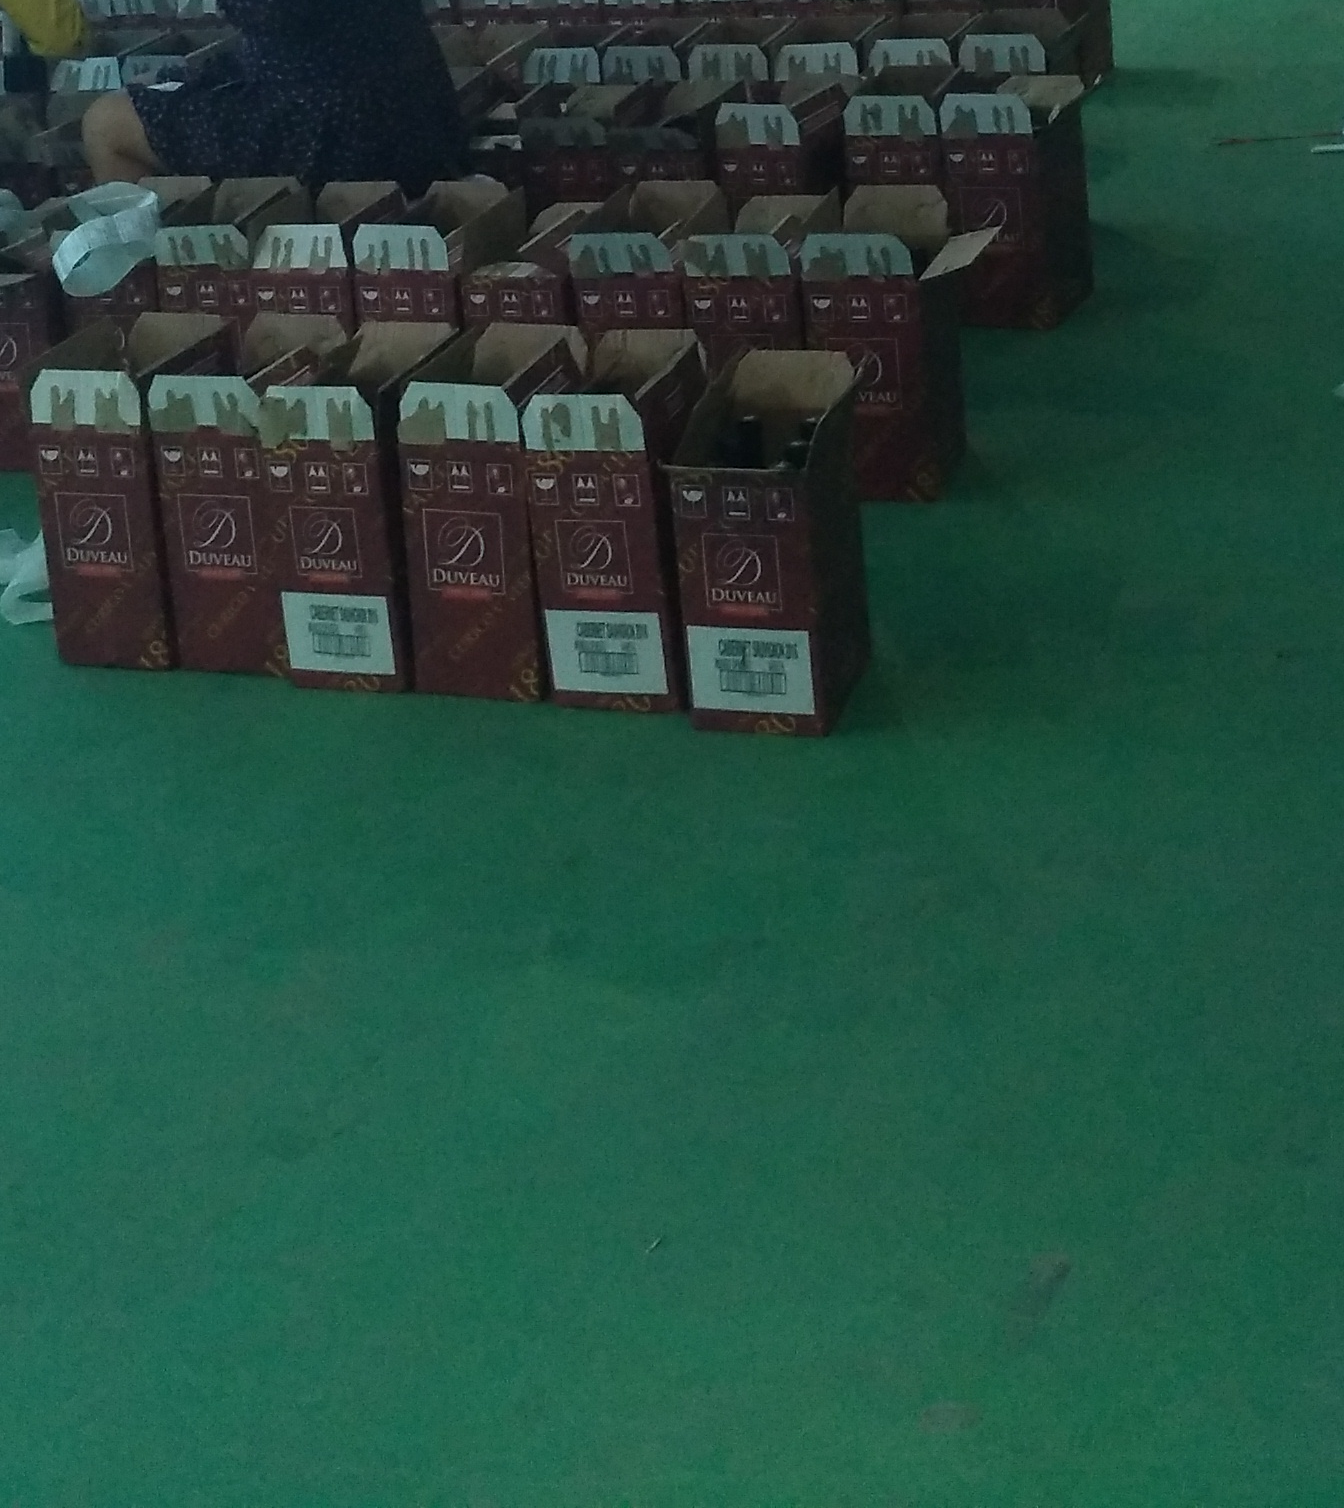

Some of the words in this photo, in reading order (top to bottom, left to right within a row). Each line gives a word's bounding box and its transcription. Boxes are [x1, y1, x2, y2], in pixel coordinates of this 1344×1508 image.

[66, 547, 128, 565] DUVEAU
[188, 549, 252, 568] DUVEAU
[300, 555, 357, 571] DUVEAU
[433, 567, 501, 588] DUVEAU
[566, 571, 628, 587] DUVEAU
[711, 587, 778, 605] DUVEAU
